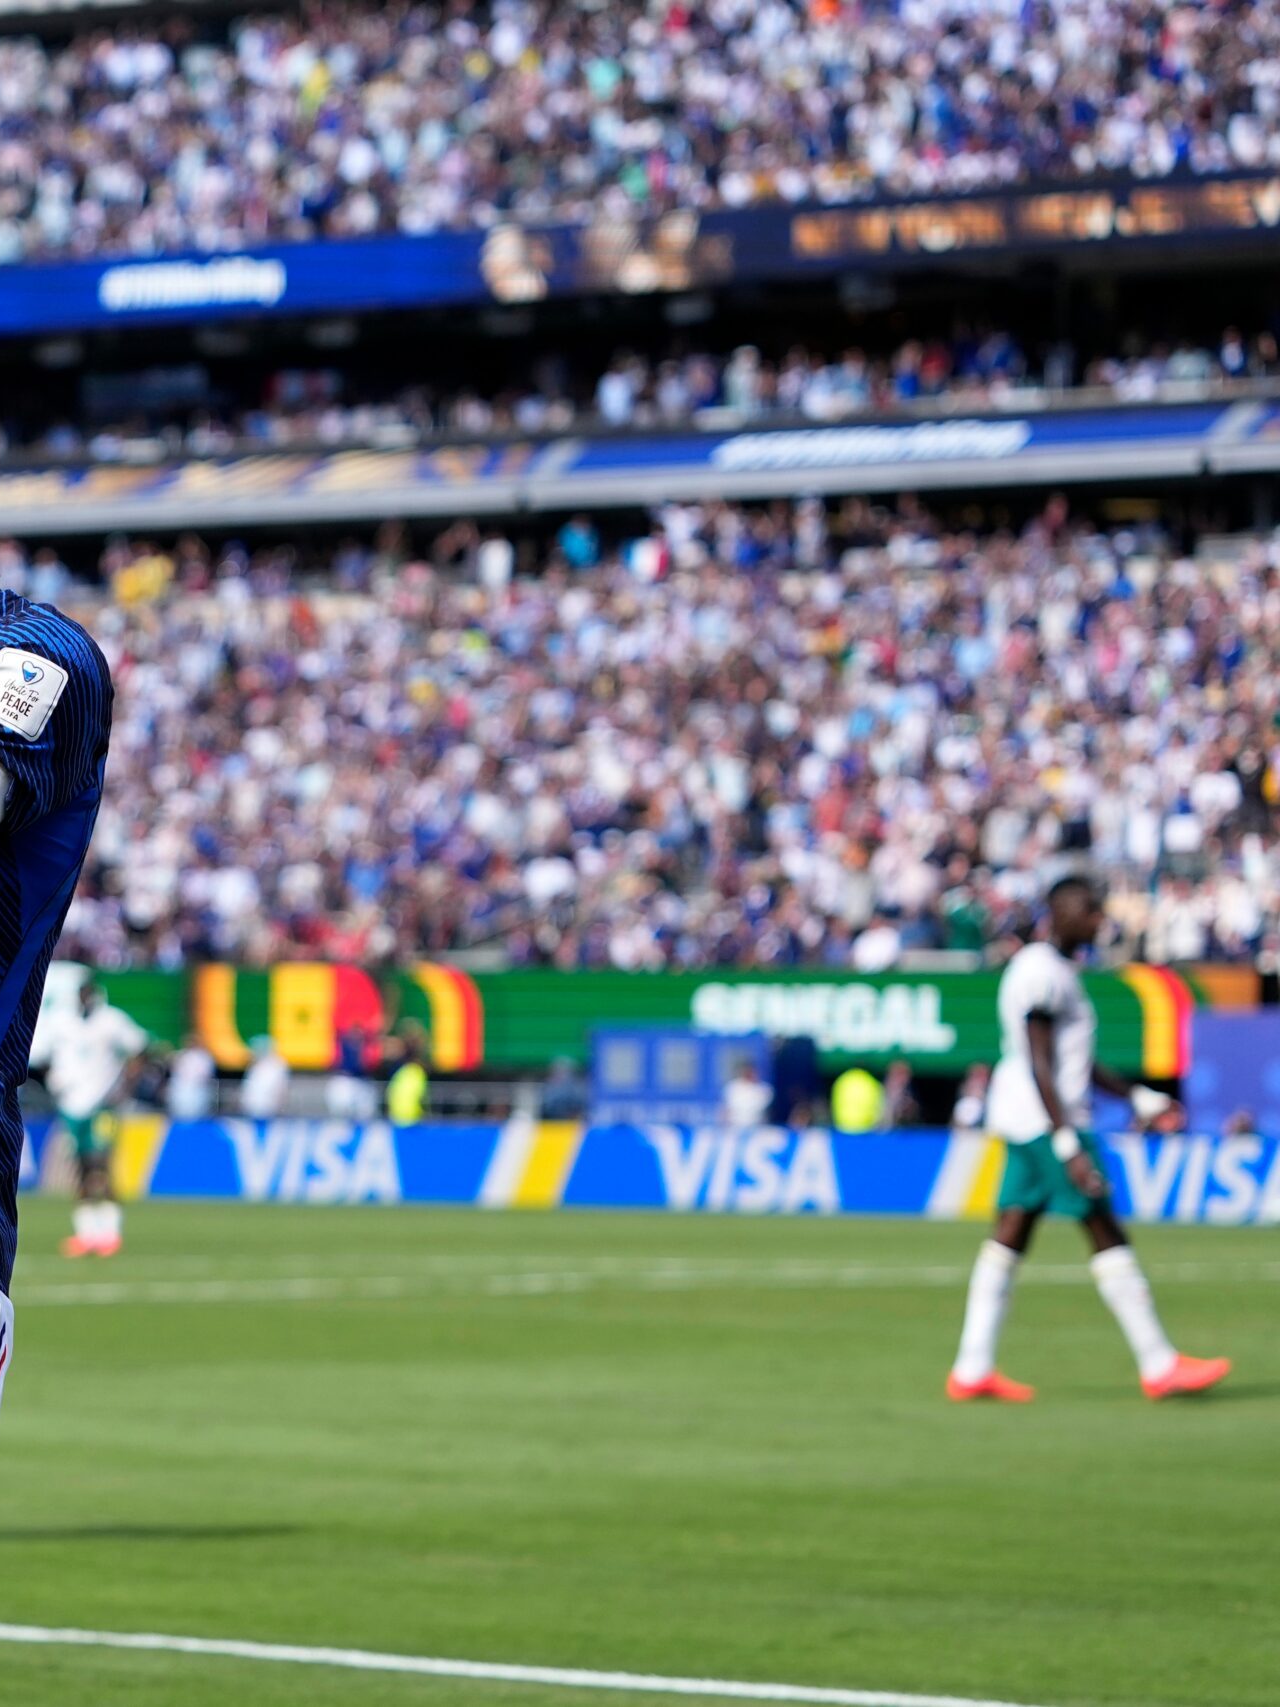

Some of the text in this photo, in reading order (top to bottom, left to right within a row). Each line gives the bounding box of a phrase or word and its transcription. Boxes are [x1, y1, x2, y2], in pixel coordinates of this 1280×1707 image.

[0, 691, 34, 717] PEACE
[2, 708, 19, 721] FIFA
[4, 679, 40, 703] Unite For
[692, 982, 957, 1052] SENEGAL
[226, 1115, 400, 1205] VISA
[648, 1124, 841, 1214] VISA
